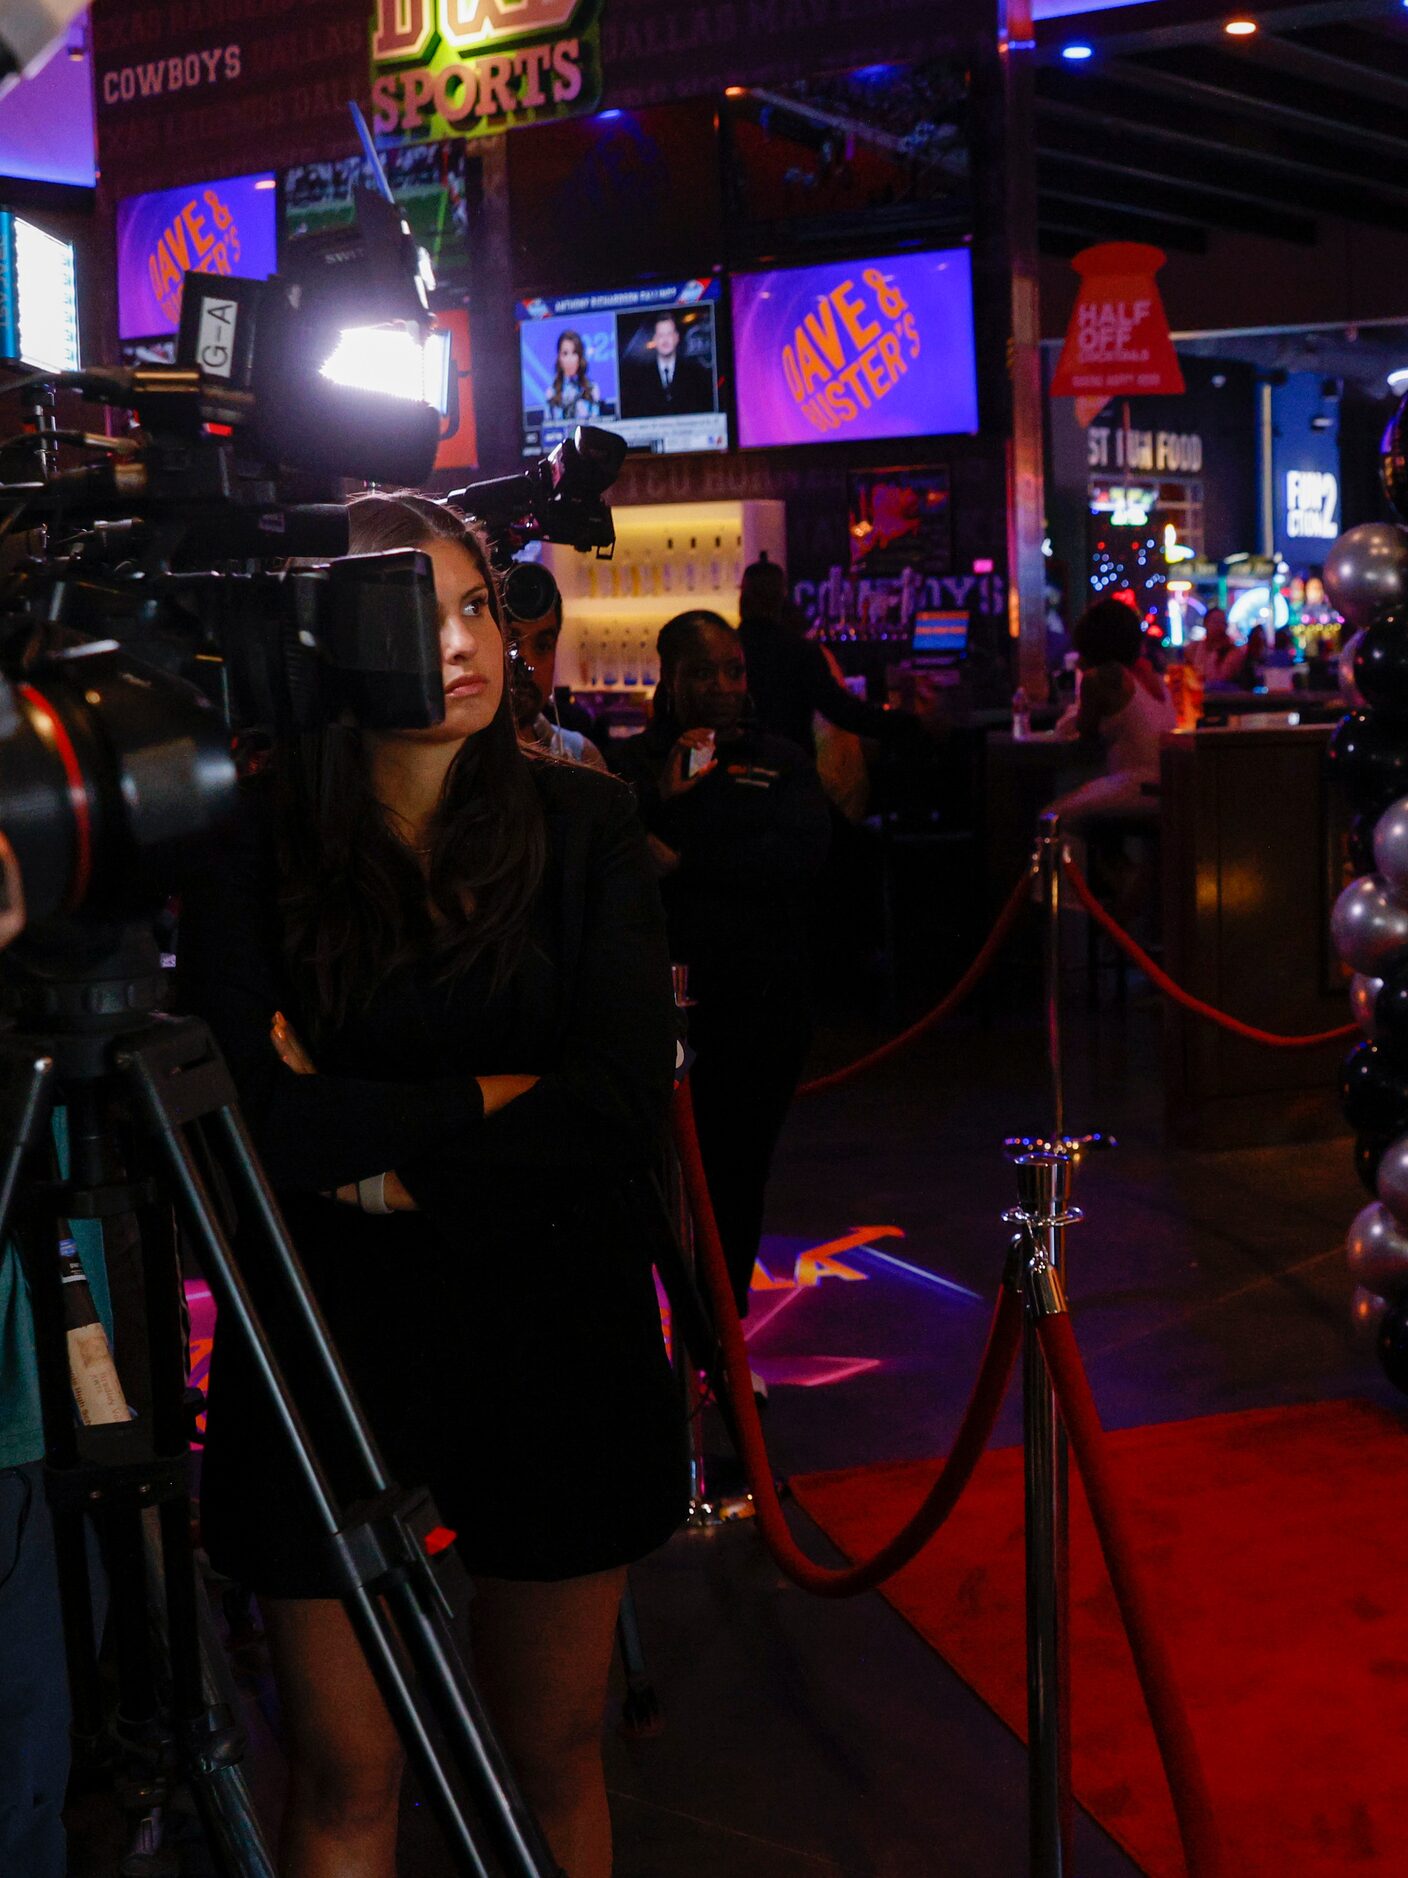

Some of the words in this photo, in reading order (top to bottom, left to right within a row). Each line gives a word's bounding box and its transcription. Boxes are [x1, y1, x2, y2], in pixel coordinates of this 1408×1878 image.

[103, 44, 242, 104] COWBOYS
[371, 38, 582, 134] SPORTS
[149, 200, 214, 303] DAVE
[203, 190, 234, 231] &
[202, 303, 234, 369] G-A
[782, 280, 880, 404] DAVE
[863, 268, 908, 319] &
[1078, 300, 1152, 328] HALF
[1079, 326, 1132, 352] OFF
[802, 313, 921, 433] BUSTER'S
[1156, 431, 1202, 472] FOOD
